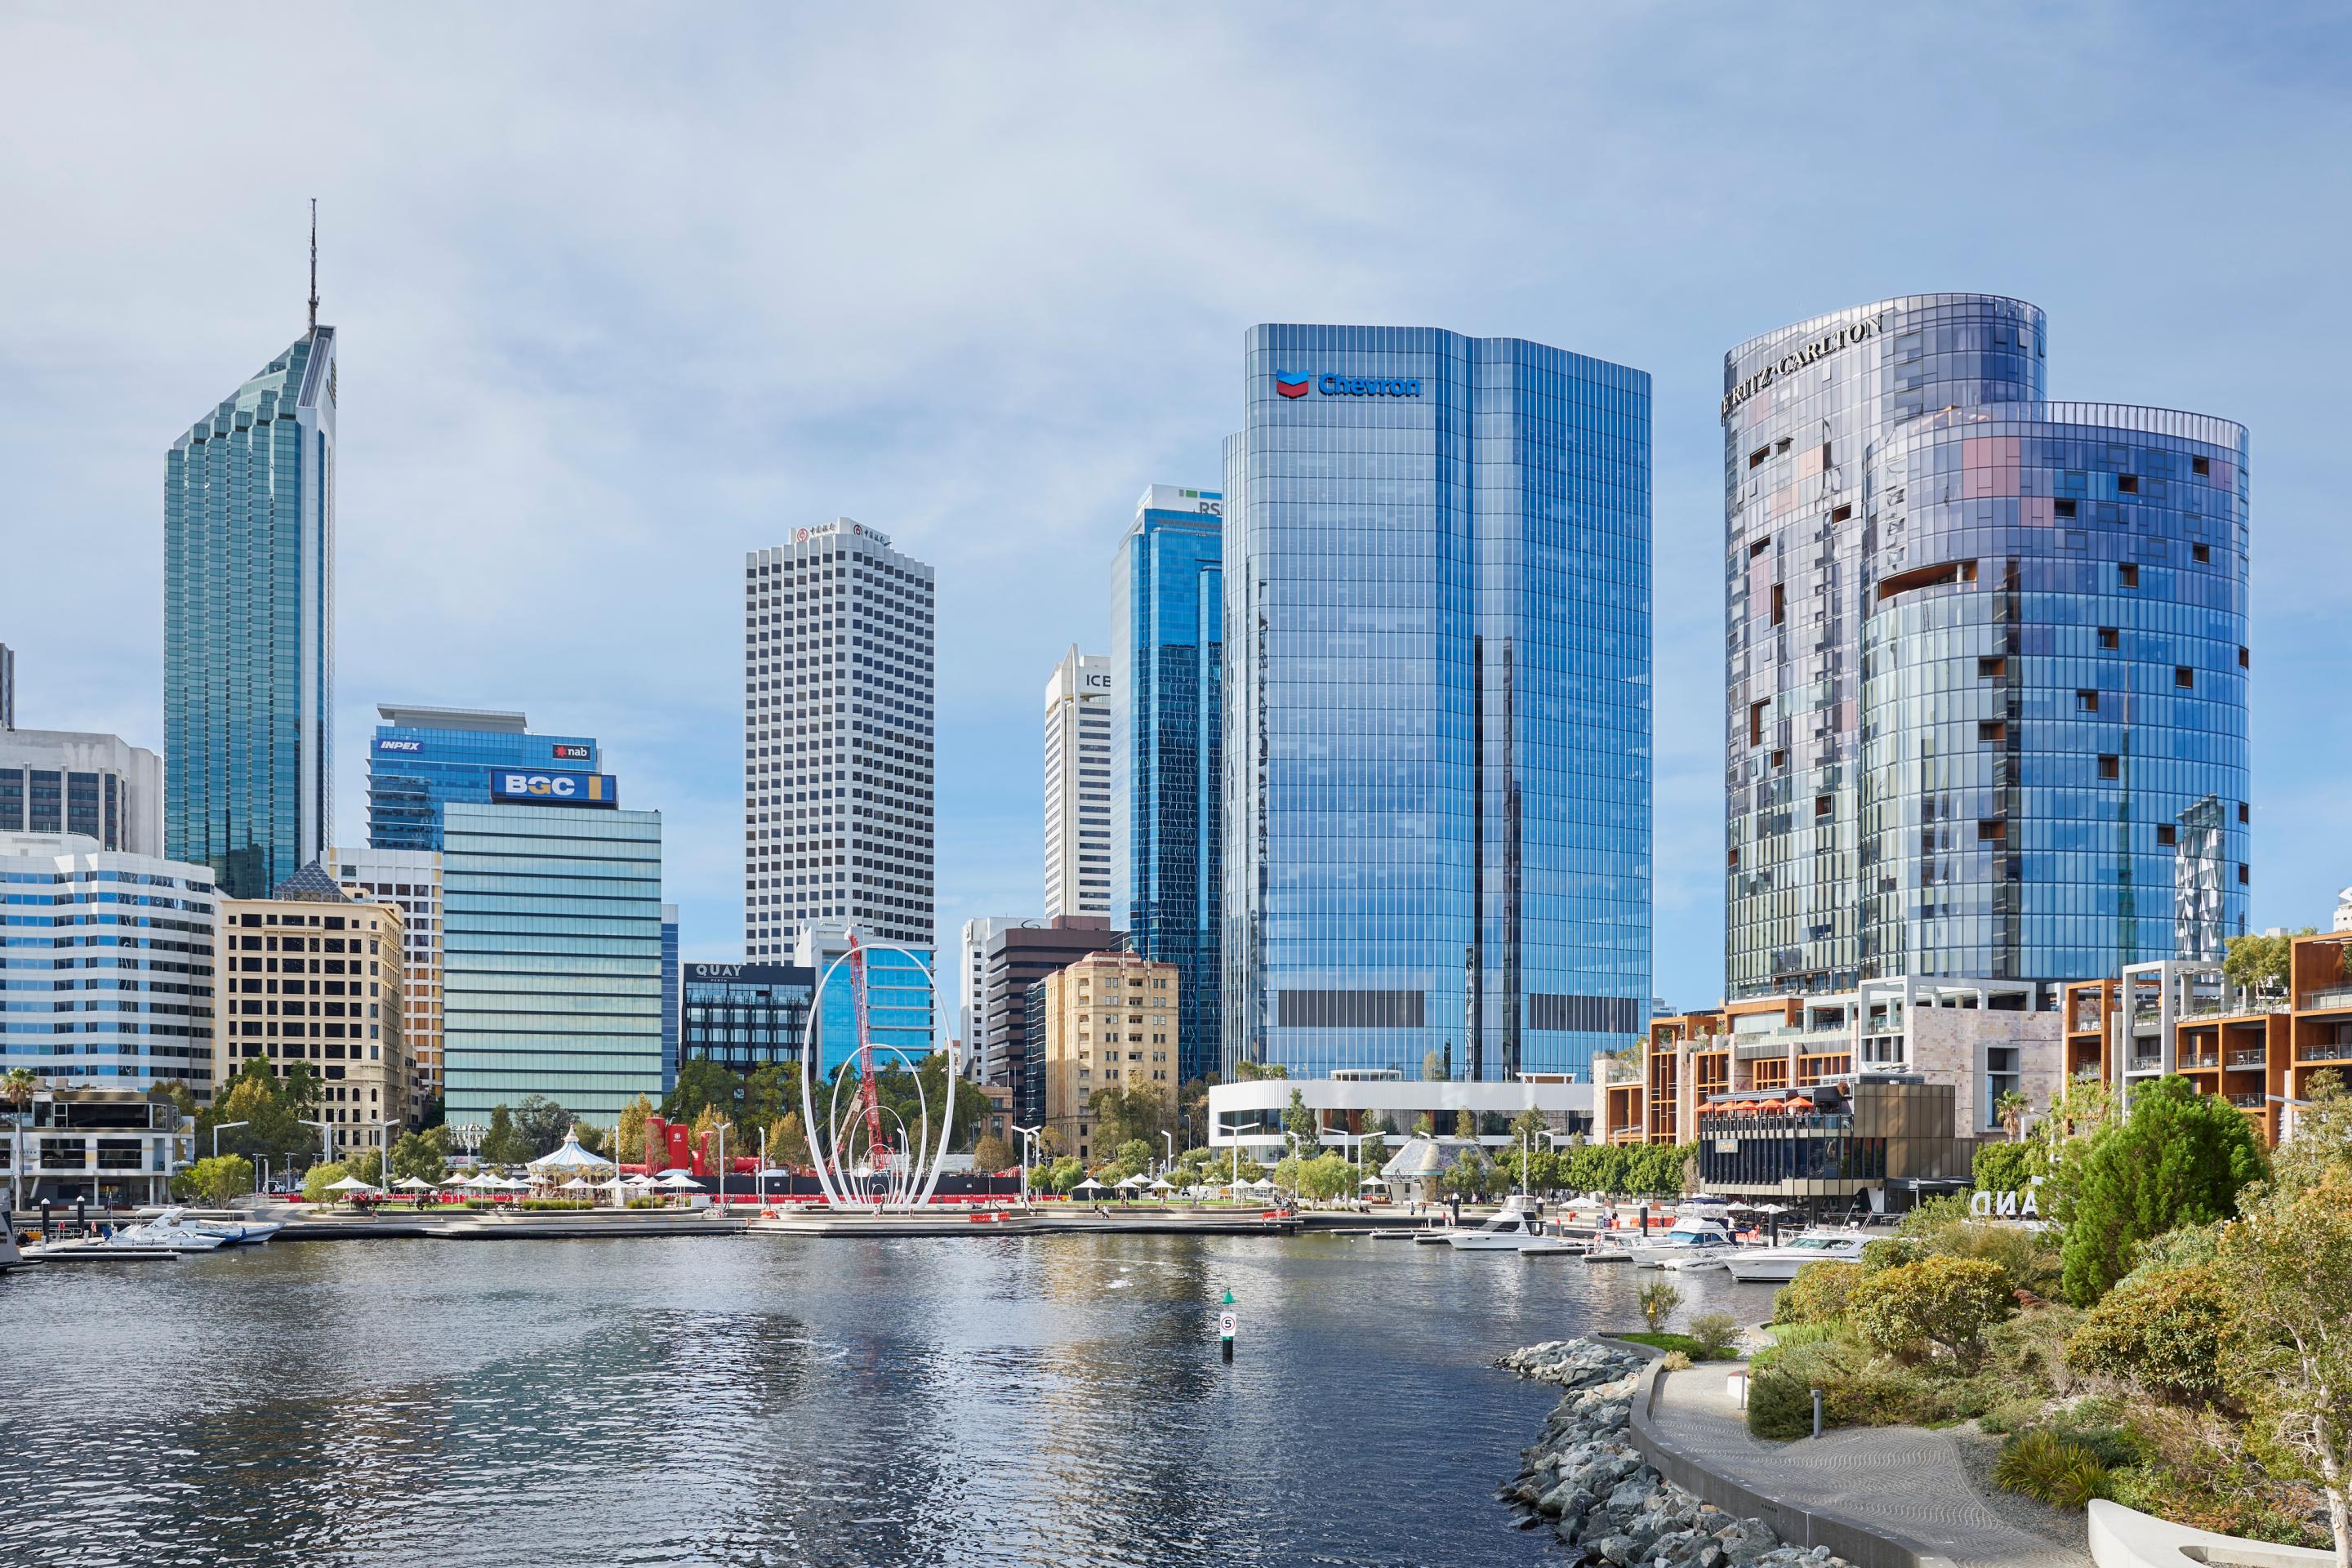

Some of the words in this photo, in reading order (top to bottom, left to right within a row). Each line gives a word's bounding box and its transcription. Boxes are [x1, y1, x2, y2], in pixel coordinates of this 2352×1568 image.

[1318, 372, 1421, 397] Chevron
[1199, 501, 1222, 515] RS
[381, 741, 421, 751] INPEX
[568, 746, 587, 757] nab
[506, 775, 575, 795] BGC
[696, 964, 742, 976] QUAY
[1225, 1319, 1232, 1328] 5
